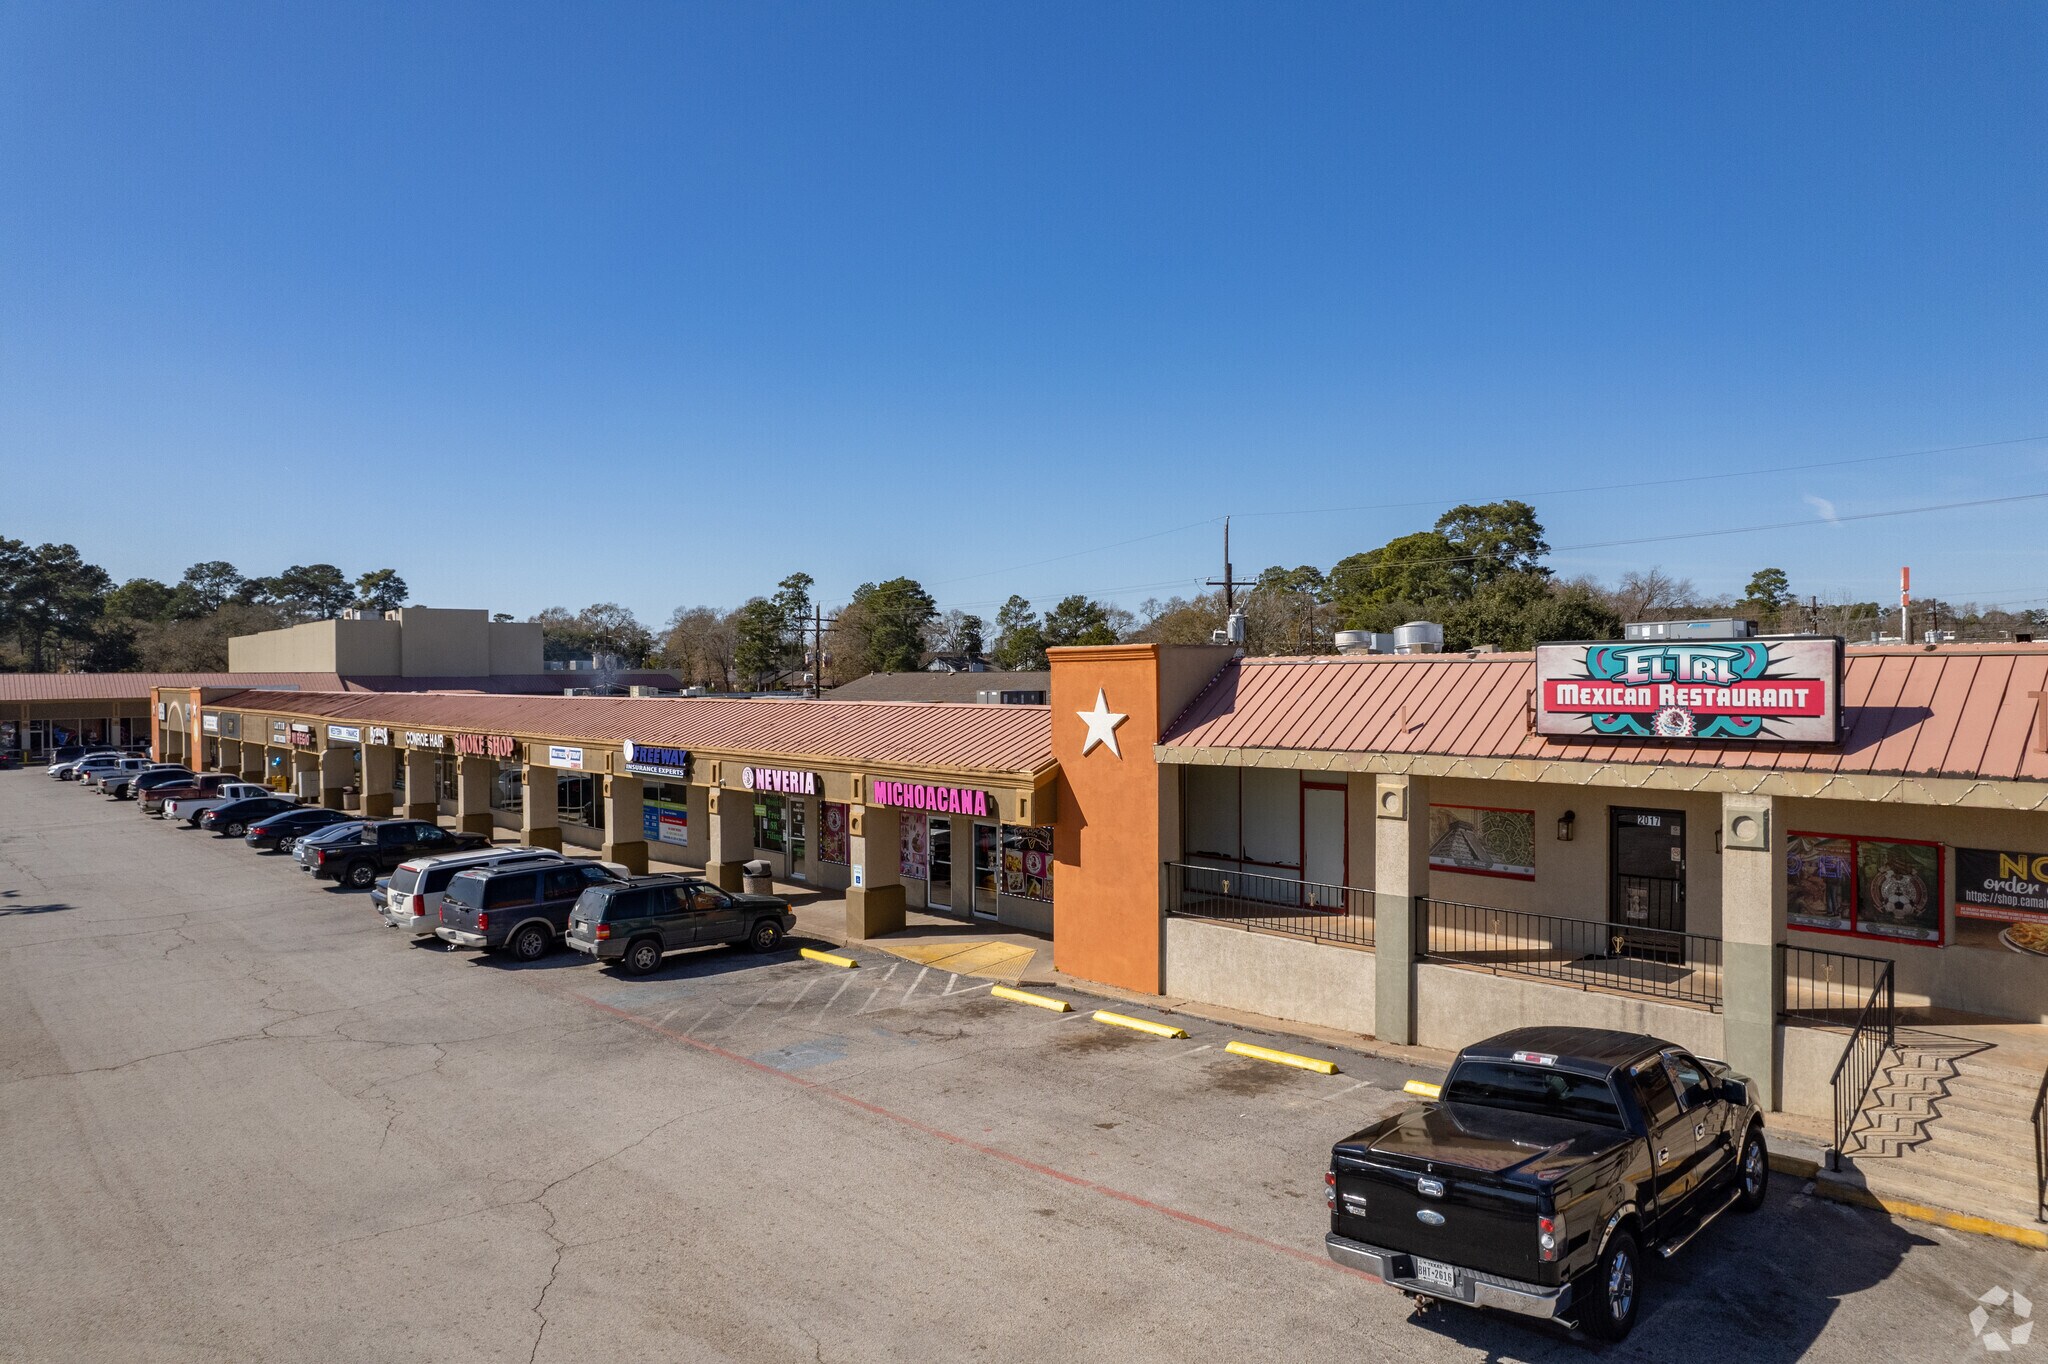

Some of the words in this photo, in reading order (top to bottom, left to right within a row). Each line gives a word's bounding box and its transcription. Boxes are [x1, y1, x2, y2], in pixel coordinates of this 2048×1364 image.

[1556, 684, 1650, 705] MEXICAN
[1659, 684, 1809, 707] RESTAURANT
[405, 731, 428, 747] CONROE
[429, 733, 444, 748] HAIR
[454, 733, 485, 755] SMOKE
[487, 735, 514, 757] SHOP
[633, 746, 688, 765] FREEWAY
[626, 763, 658, 773] INSURANCE
[658, 767, 684, 776] EXPERTS
[756, 769, 815, 795] NEVERIA
[874, 782, 986, 816] MICHOACANA
[1637, 815, 1661, 827] 2017
[1984, 876, 2040, 895] order
